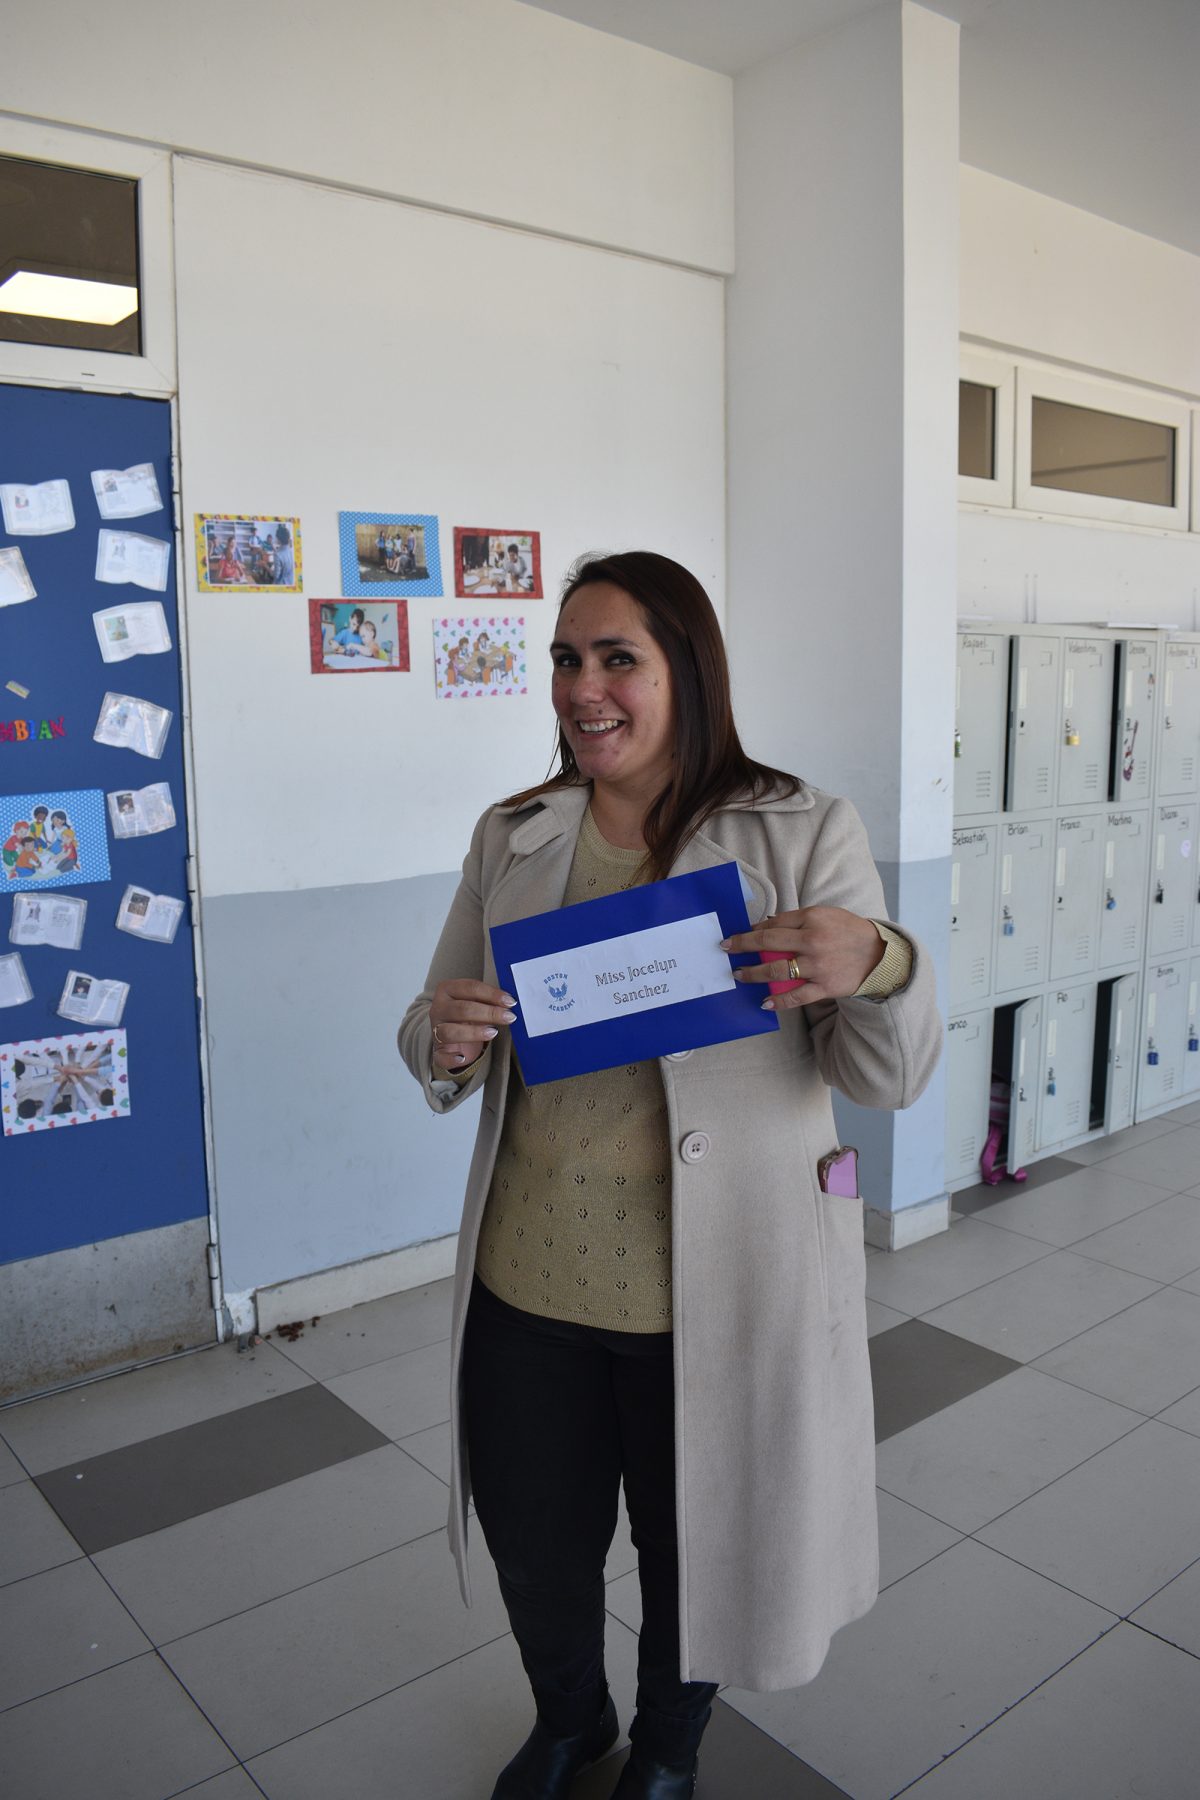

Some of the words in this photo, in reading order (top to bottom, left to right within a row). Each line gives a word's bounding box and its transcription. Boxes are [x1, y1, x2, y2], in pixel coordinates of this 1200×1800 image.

[543, 973, 568, 984] BOSTON
[595, 971, 625, 987] Miss
[627, 958, 677, 982] Jocelyn
[613, 983, 670, 1005] Sanchez
[548, 999, 576, 1012] ACADEMY
